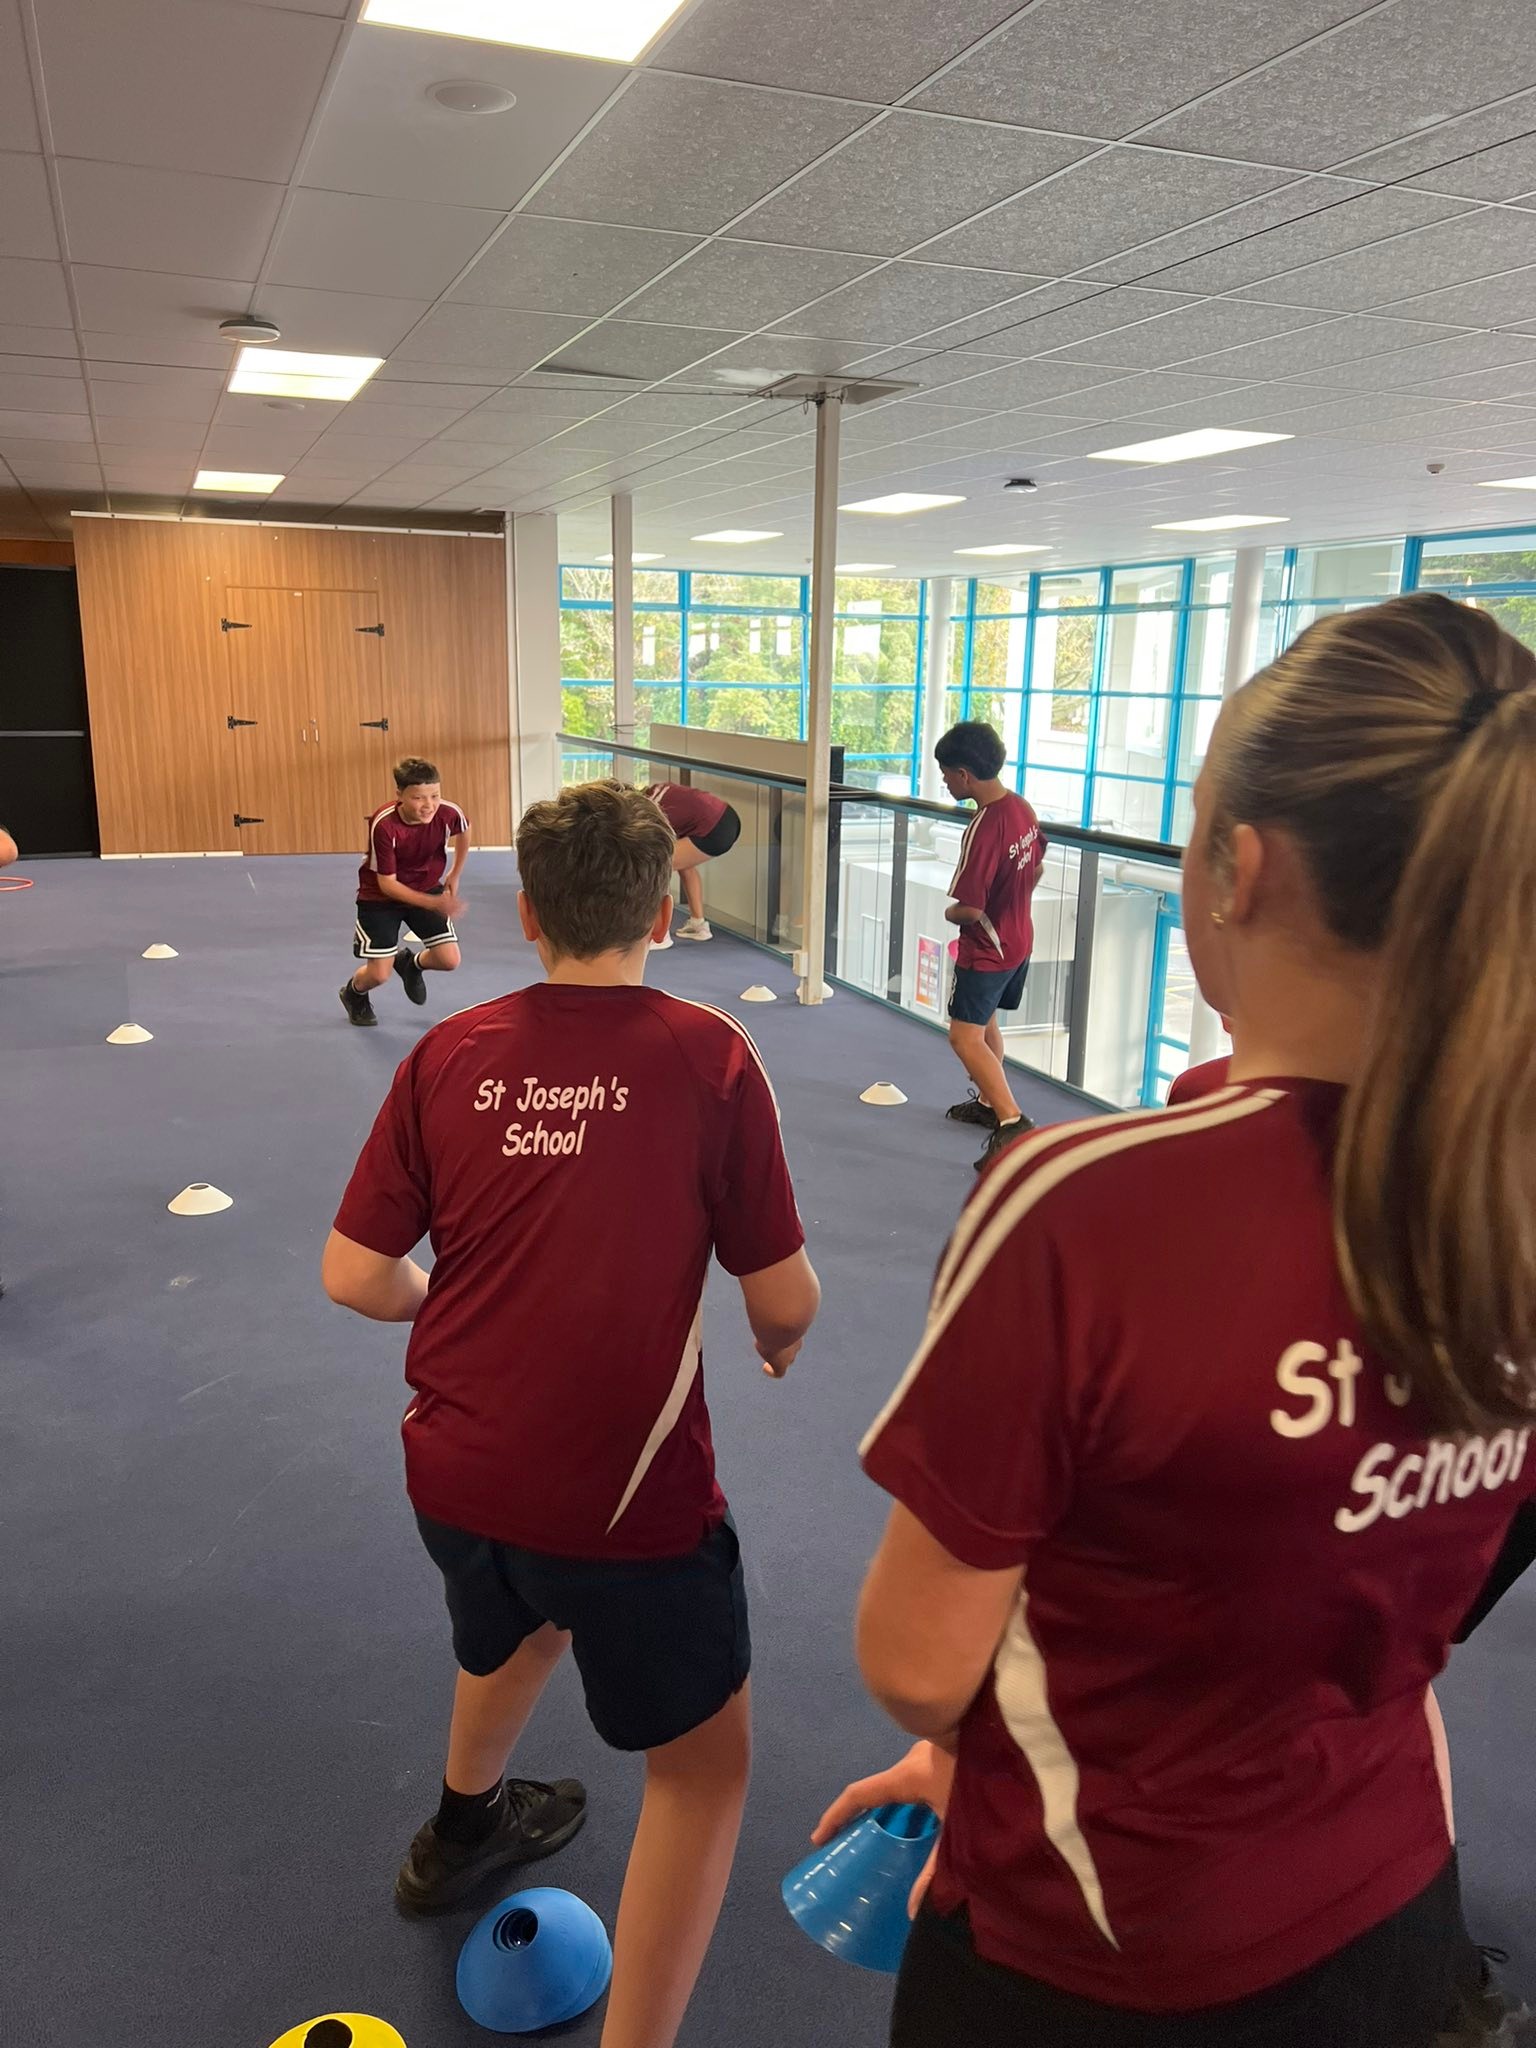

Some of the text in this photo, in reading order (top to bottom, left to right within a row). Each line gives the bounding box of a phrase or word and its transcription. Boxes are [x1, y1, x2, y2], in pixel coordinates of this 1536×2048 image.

[1009, 842, 1020, 859] St
[474, 1075, 629, 1120] St Joseph's
[502, 1120, 587, 1157] School
[1270, 1338, 1363, 1438] St
